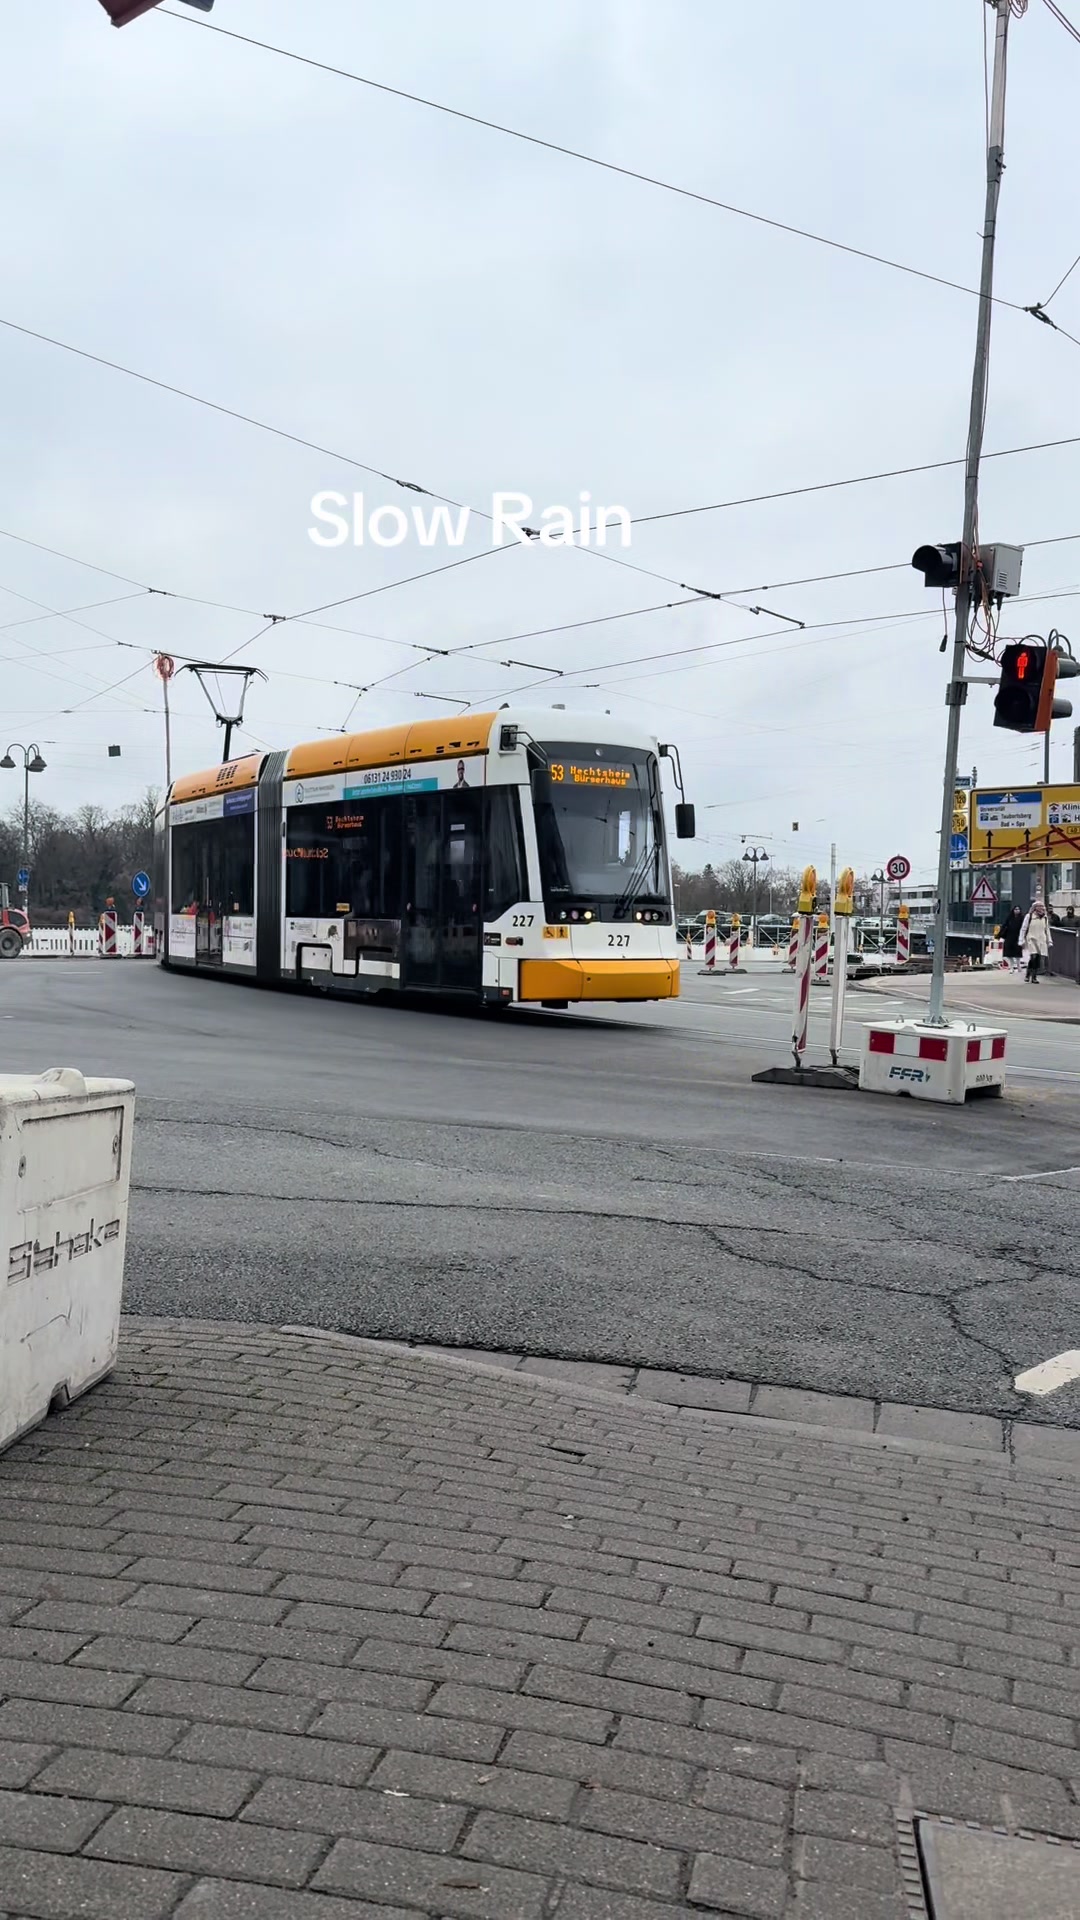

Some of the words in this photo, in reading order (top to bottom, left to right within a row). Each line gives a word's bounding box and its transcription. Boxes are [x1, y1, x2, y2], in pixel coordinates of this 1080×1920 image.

[363, 772, 381, 784] 06131
[382, 771, 390, 782] 24
[403, 768, 412, 780] 24
[551, 764, 564, 781] 53
[570, 765, 631, 779] Hechtsheim
[574, 774, 627, 786] Bürgerhaus
[891, 862, 906, 874] 30
[512, 915, 535, 927] 227
[607, 935, 631, 947] 227
